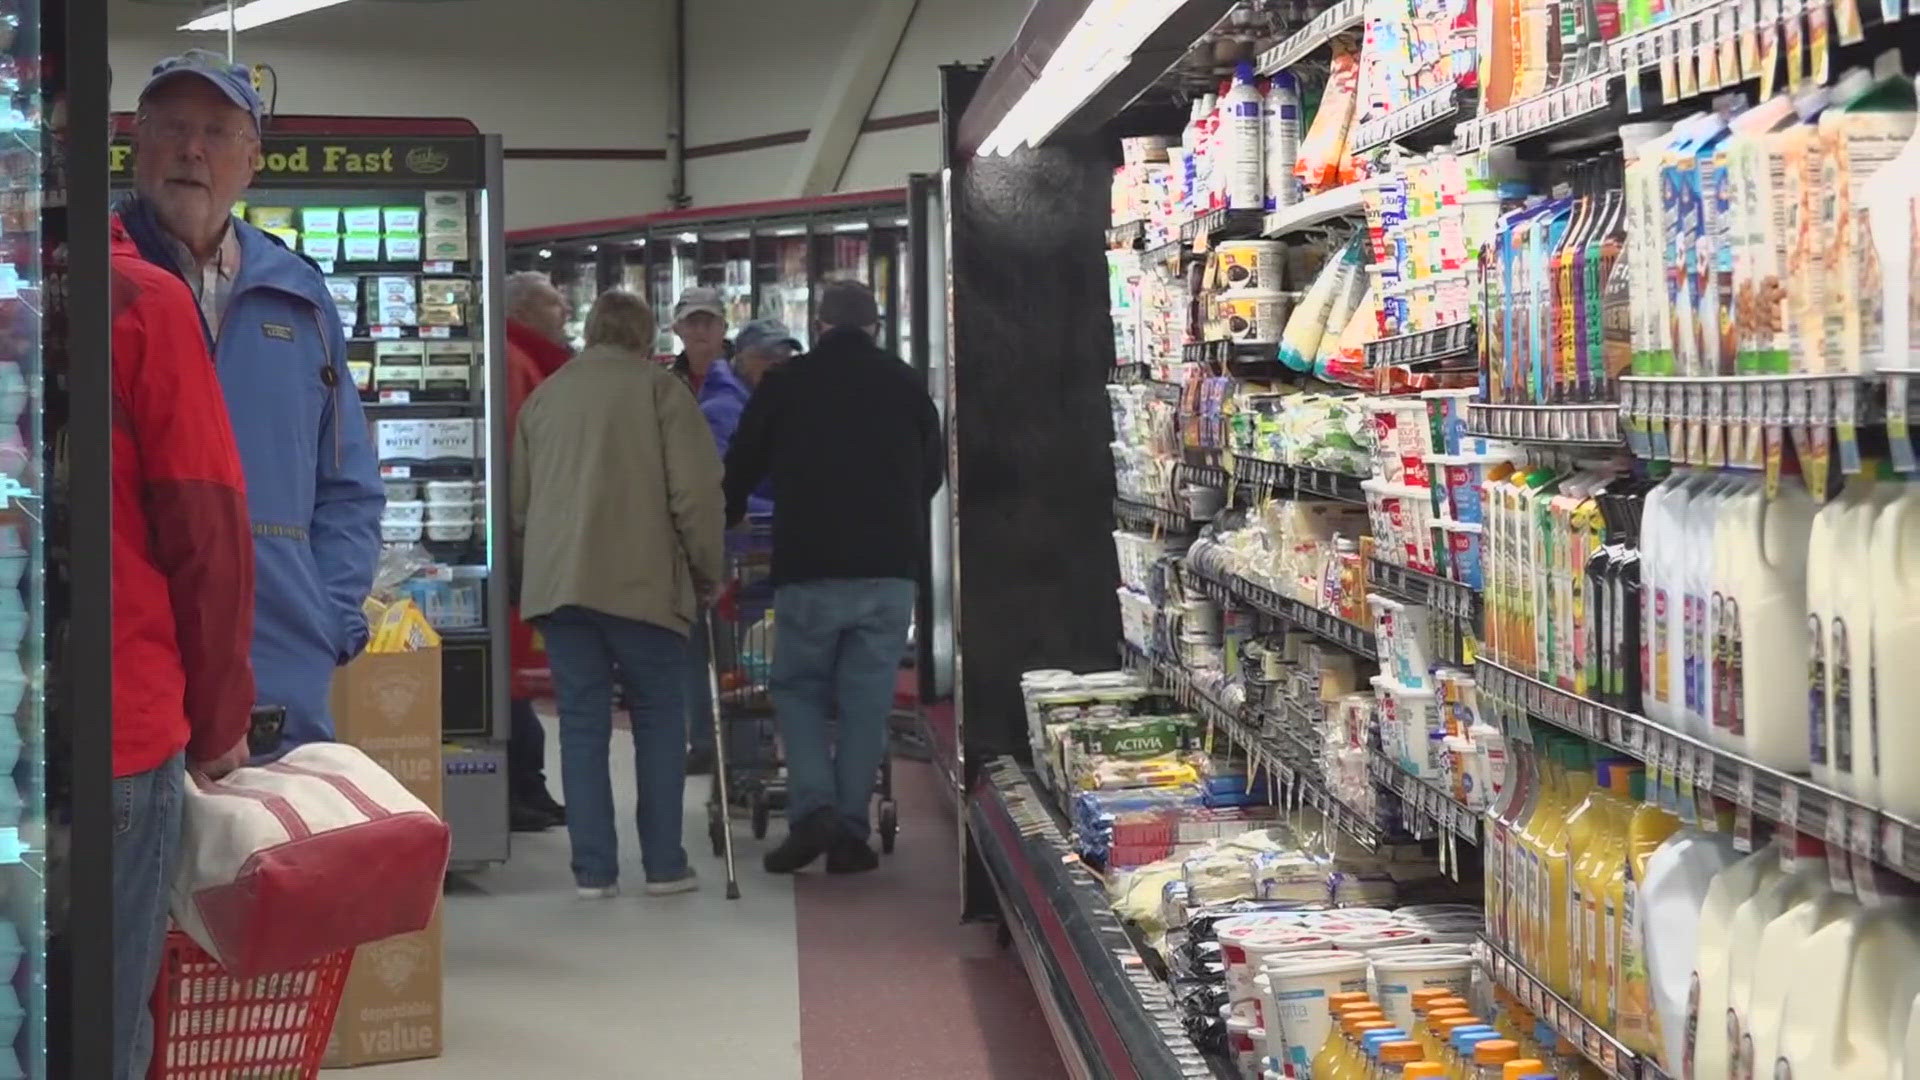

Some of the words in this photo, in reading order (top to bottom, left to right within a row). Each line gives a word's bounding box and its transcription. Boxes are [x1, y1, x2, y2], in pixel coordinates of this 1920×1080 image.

[253, 146, 309, 172] ood
[323, 146, 394, 172] Fast
[1114, 736, 1163, 751] ACTIVIA
[378, 752, 432, 781] alue
[360, 1000, 432, 1024] dependable
[359, 1022, 433, 1056] value
